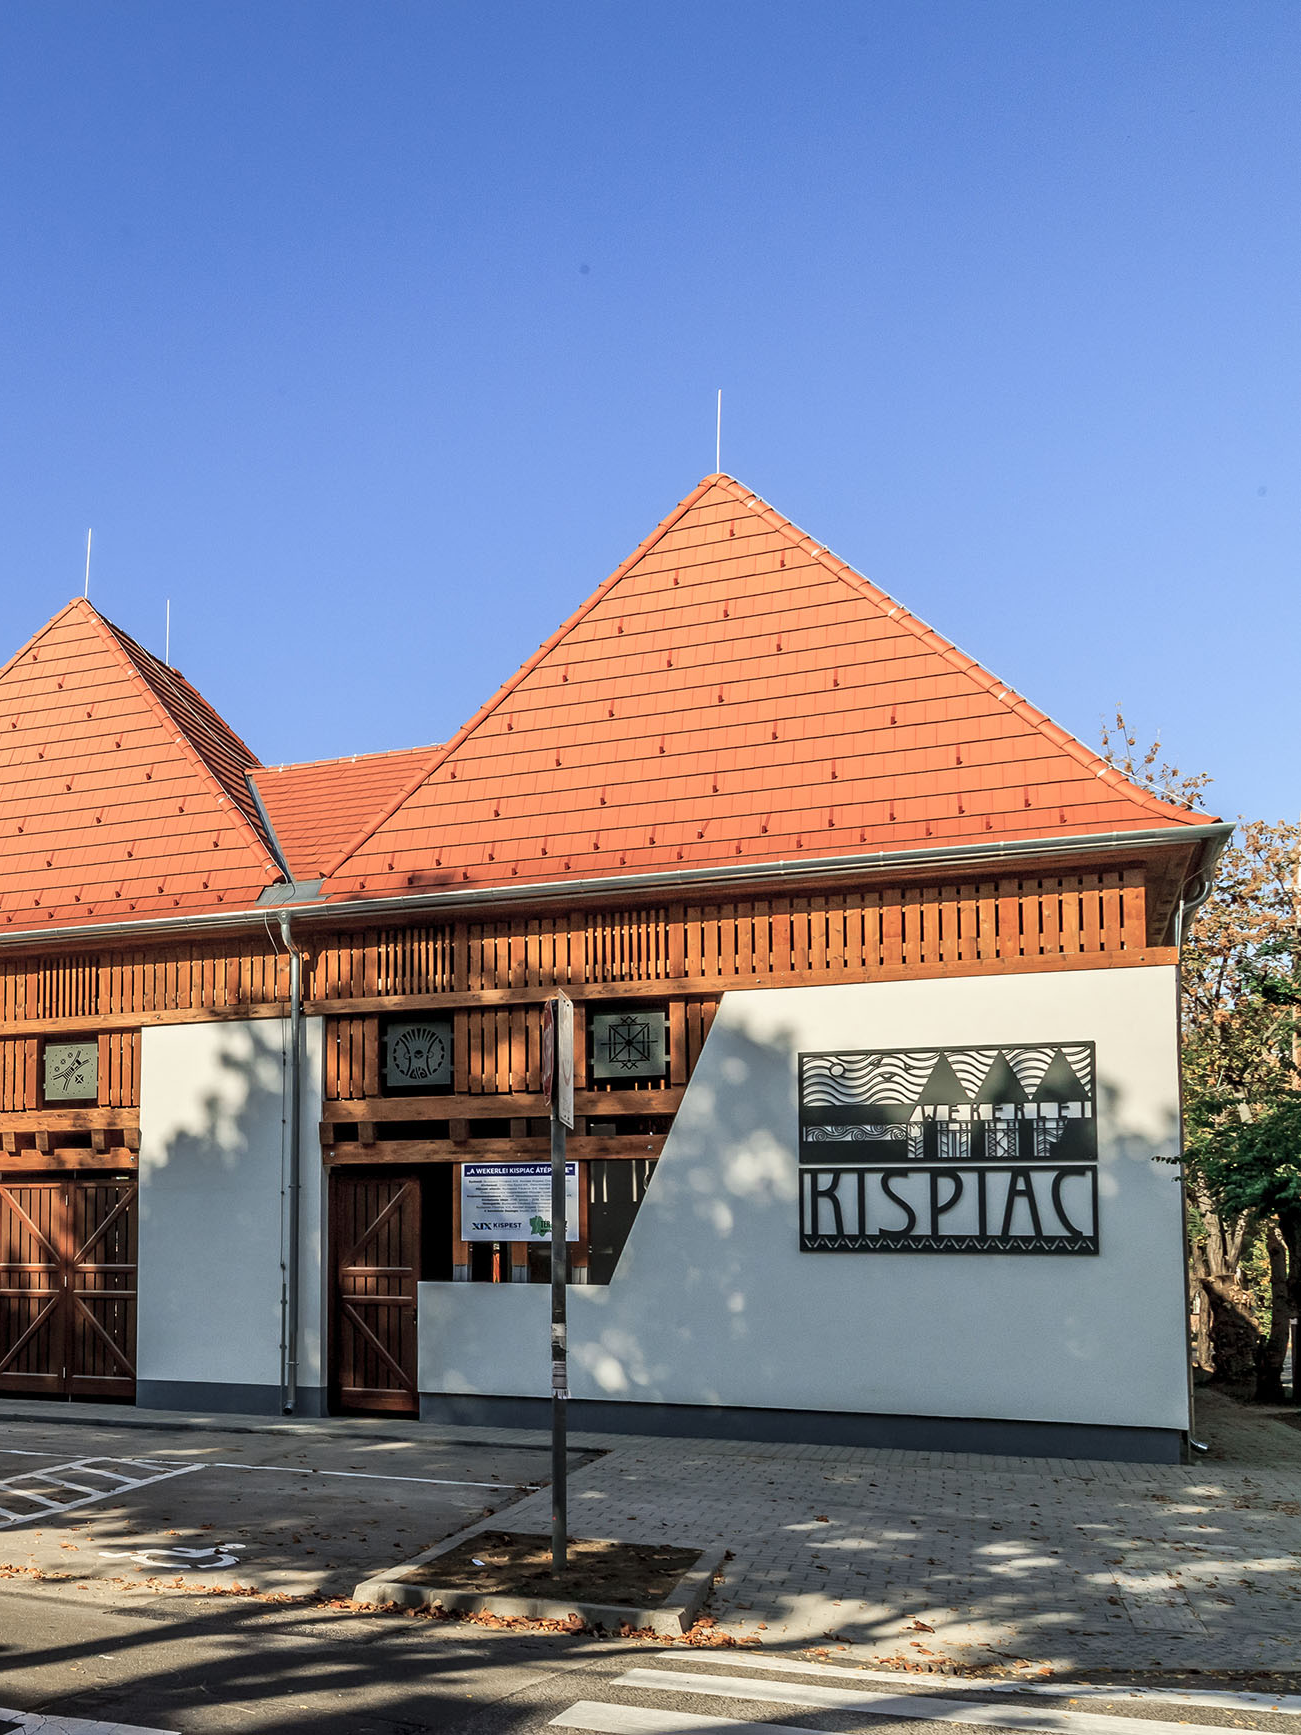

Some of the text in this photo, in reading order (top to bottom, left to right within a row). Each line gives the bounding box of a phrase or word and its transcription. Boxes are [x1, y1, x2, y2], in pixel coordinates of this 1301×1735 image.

[476, 1167, 509, 1175] WEKERLEI
[809, 1171, 1087, 1237] KISPIAC
[472, 1222, 492, 1230] XIX
